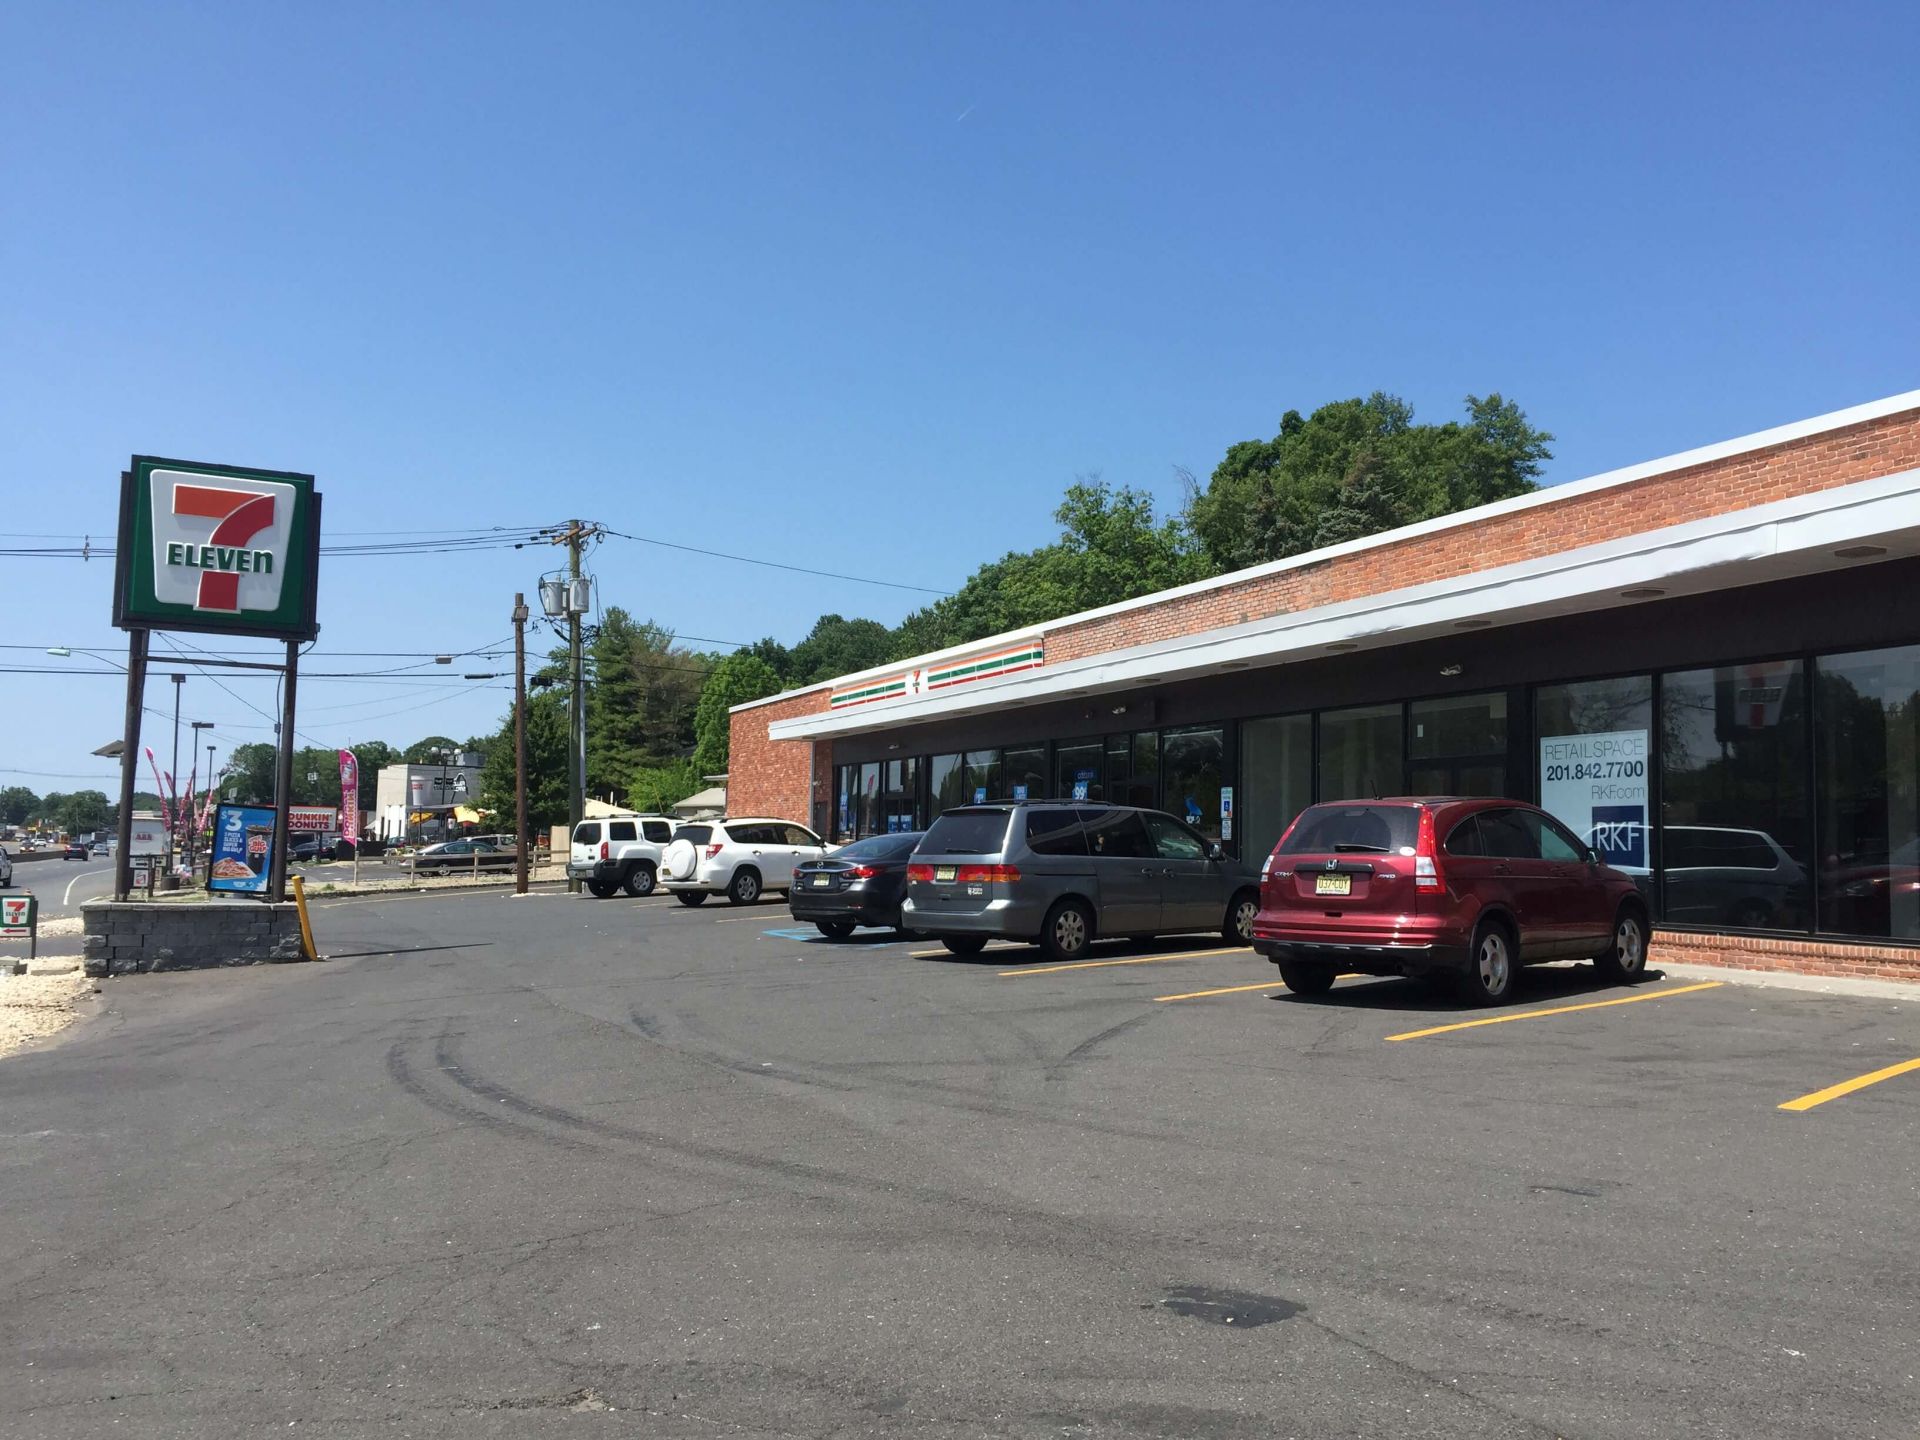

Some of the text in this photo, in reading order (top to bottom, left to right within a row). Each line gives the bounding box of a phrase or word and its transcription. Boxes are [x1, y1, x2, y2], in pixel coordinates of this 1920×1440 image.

[172, 483, 275, 611] 7
[1545, 738, 1645, 760] RETAIL SPACE
[1546, 760, 1644, 781] 201.842.7700
[1591, 784, 1645, 800] RKF.com
[288, 821, 330, 829] DONUTS
[1596, 821, 1641, 851] RKF
[7, 901, 26, 923] 7
